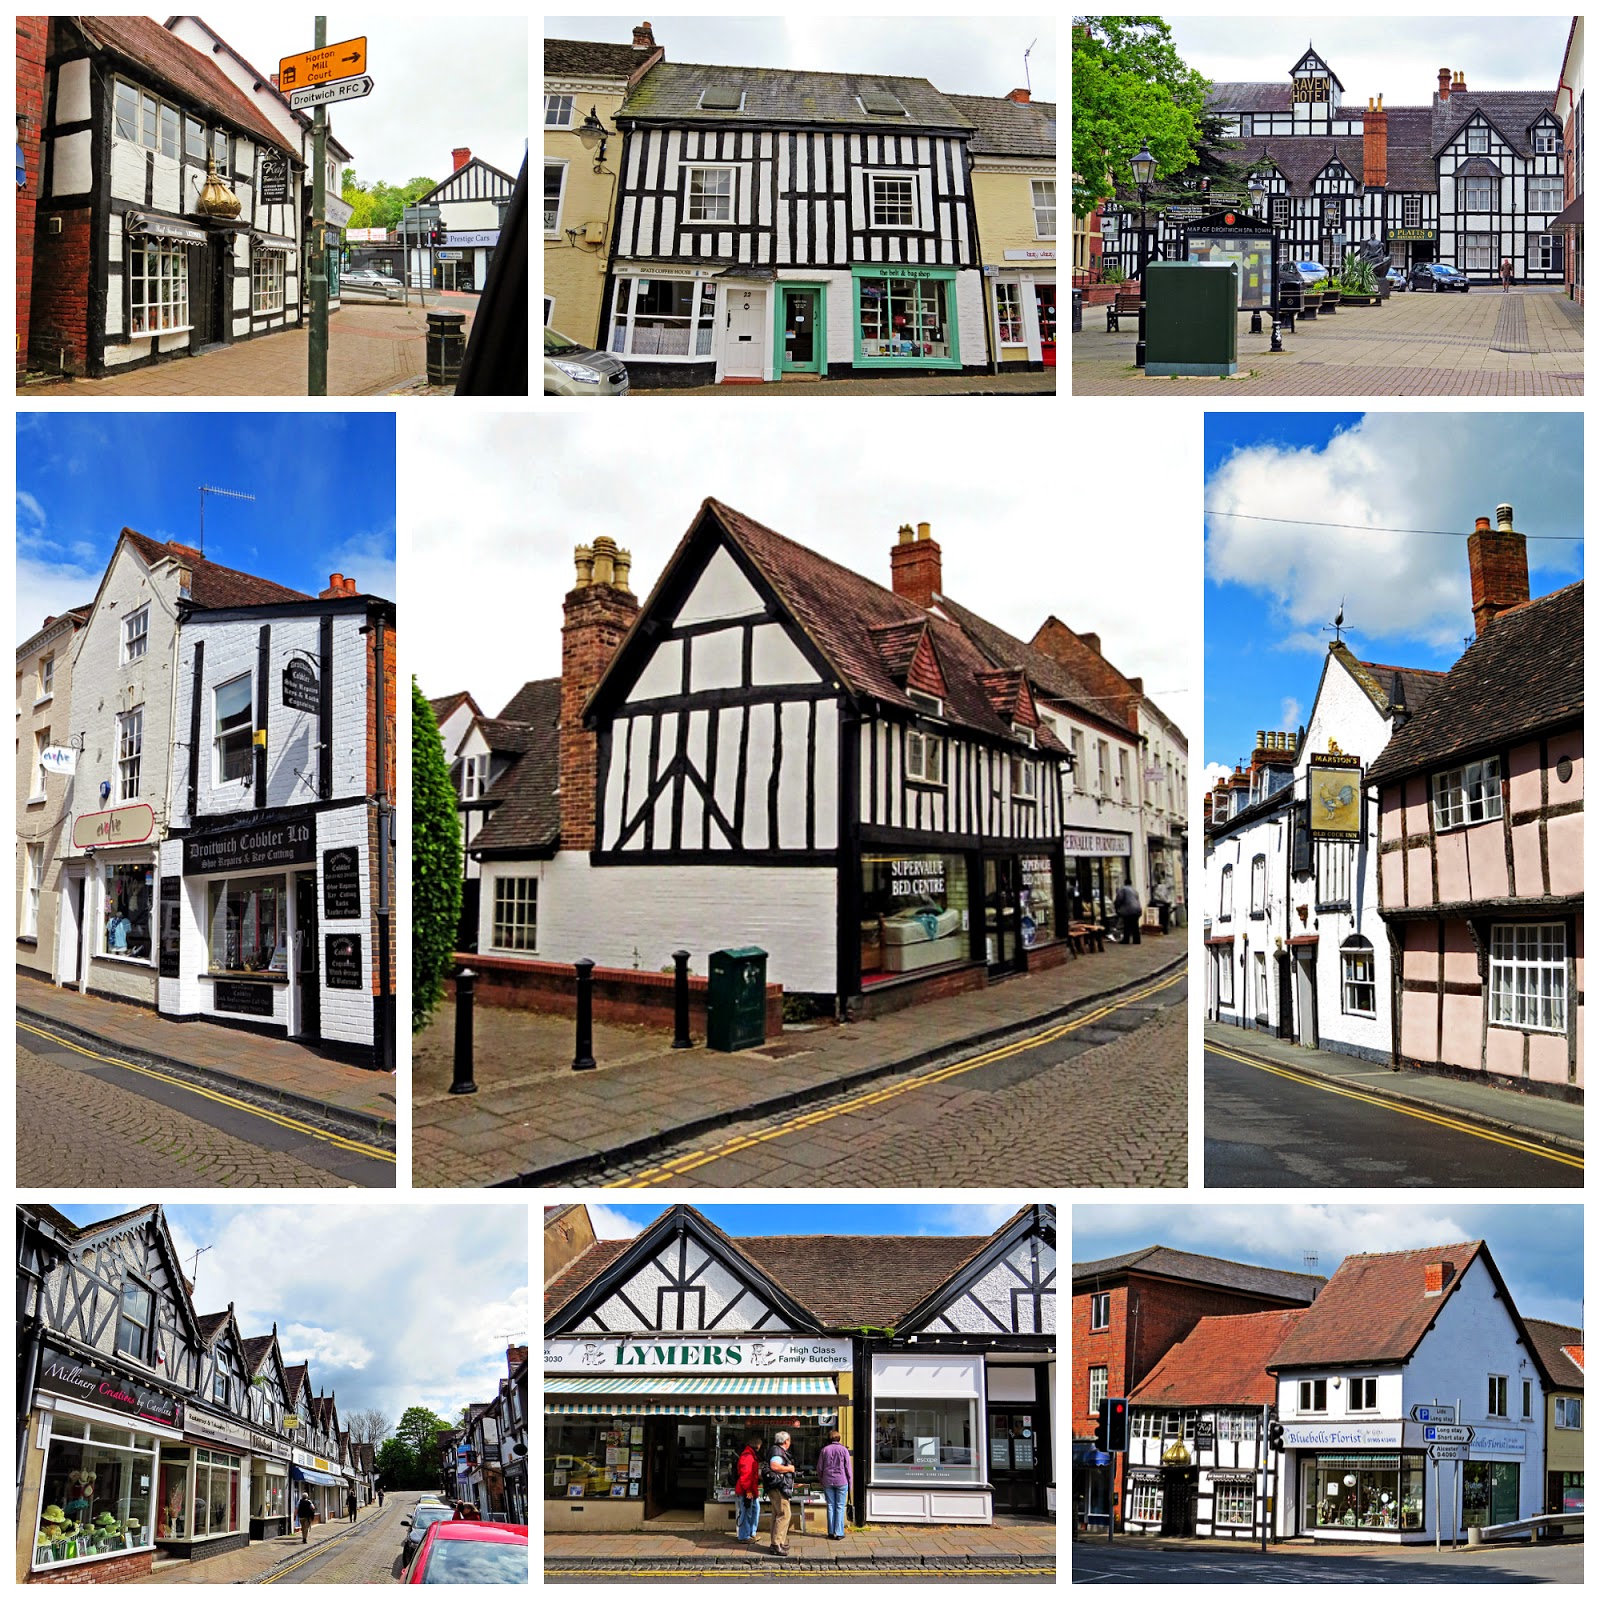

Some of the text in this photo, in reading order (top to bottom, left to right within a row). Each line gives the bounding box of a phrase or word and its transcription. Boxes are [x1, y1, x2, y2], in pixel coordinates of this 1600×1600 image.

[306, 51, 335, 63] Horton
[312, 61, 328, 71] Mill
[307, 70, 332, 82] Court
[1292, 78, 1330, 90] RAVEN
[294, 83, 359, 105] Droitwich RFC
[1292, 90, 1330, 102] HOTEL
[450, 235, 474, 244] Prestige
[907, 270, 918, 278] bag
[1315, 755, 1357, 764] MARSTON'S
[189, 824, 310, 859] Droitwich Cobbler Ltd
[1064, 835, 1093, 850] ERVALUE
[201, 849, 295, 869] Shoe Repairs & Key Cutting
[891, 860, 944, 876] SUPERVALUE
[892, 878, 945, 896] BED CENTRE
[615, 1345, 742, 1366] LYMERS
[789, 1346, 836, 1355] High Class
[778, 1355, 847, 1364] Family Butchers
[45, 1363, 96, 1399] Millinery
[99, 1382, 135, 1404] Creations
[134, 1392, 146, 1414] by
[1421, 1410, 1428, 1419] P
[1288, 1431, 1361, 1443] Bluebells Florist
[1427, 1429, 1434, 1438] P
